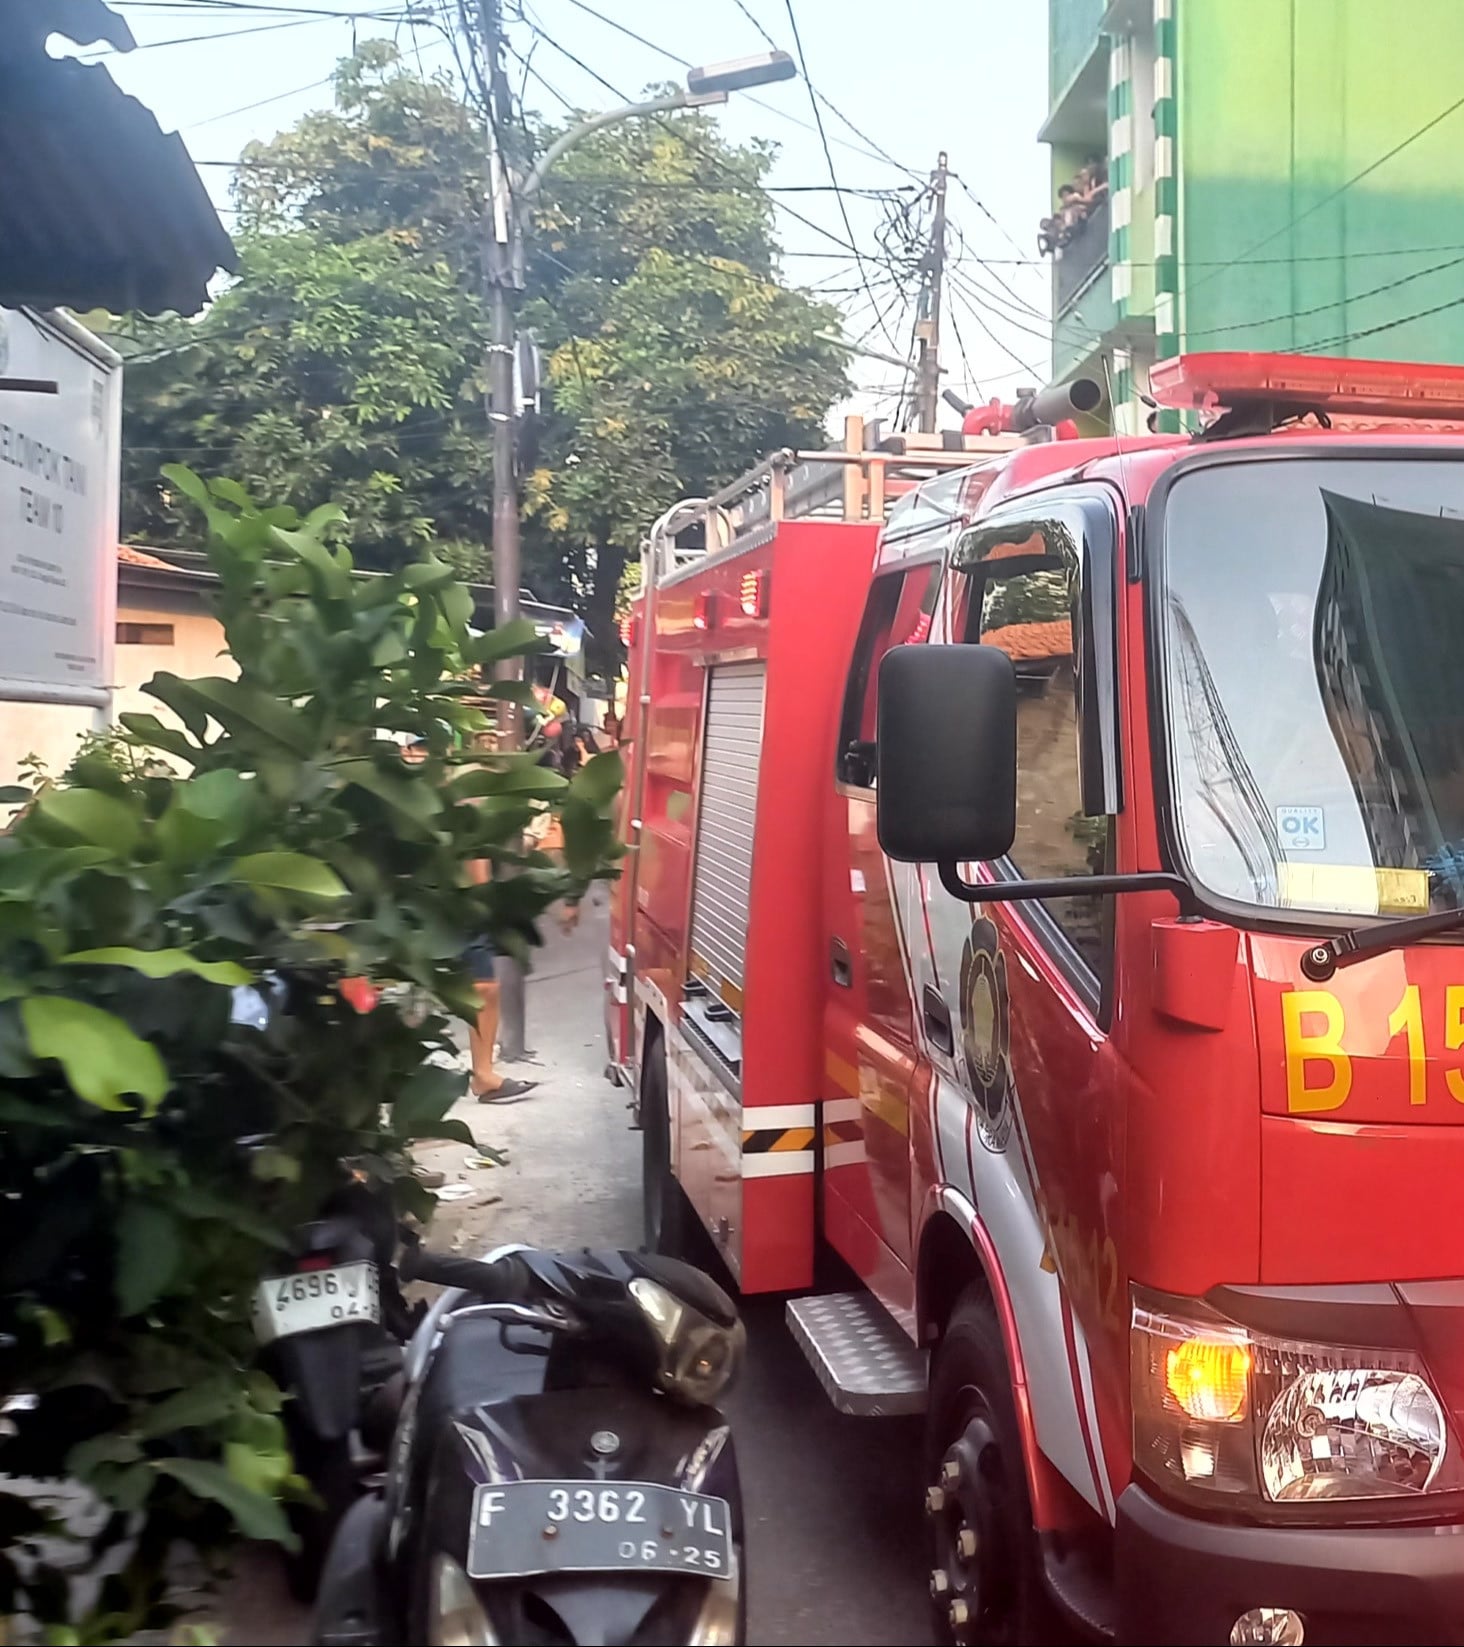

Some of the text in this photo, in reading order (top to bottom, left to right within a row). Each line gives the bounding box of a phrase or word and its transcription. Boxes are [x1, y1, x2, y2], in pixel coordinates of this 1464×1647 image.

[1282, 816, 1319, 834] OK
[1281, 990, 1353, 1113] B
[479, 1489, 724, 1536] F 3362 YL
